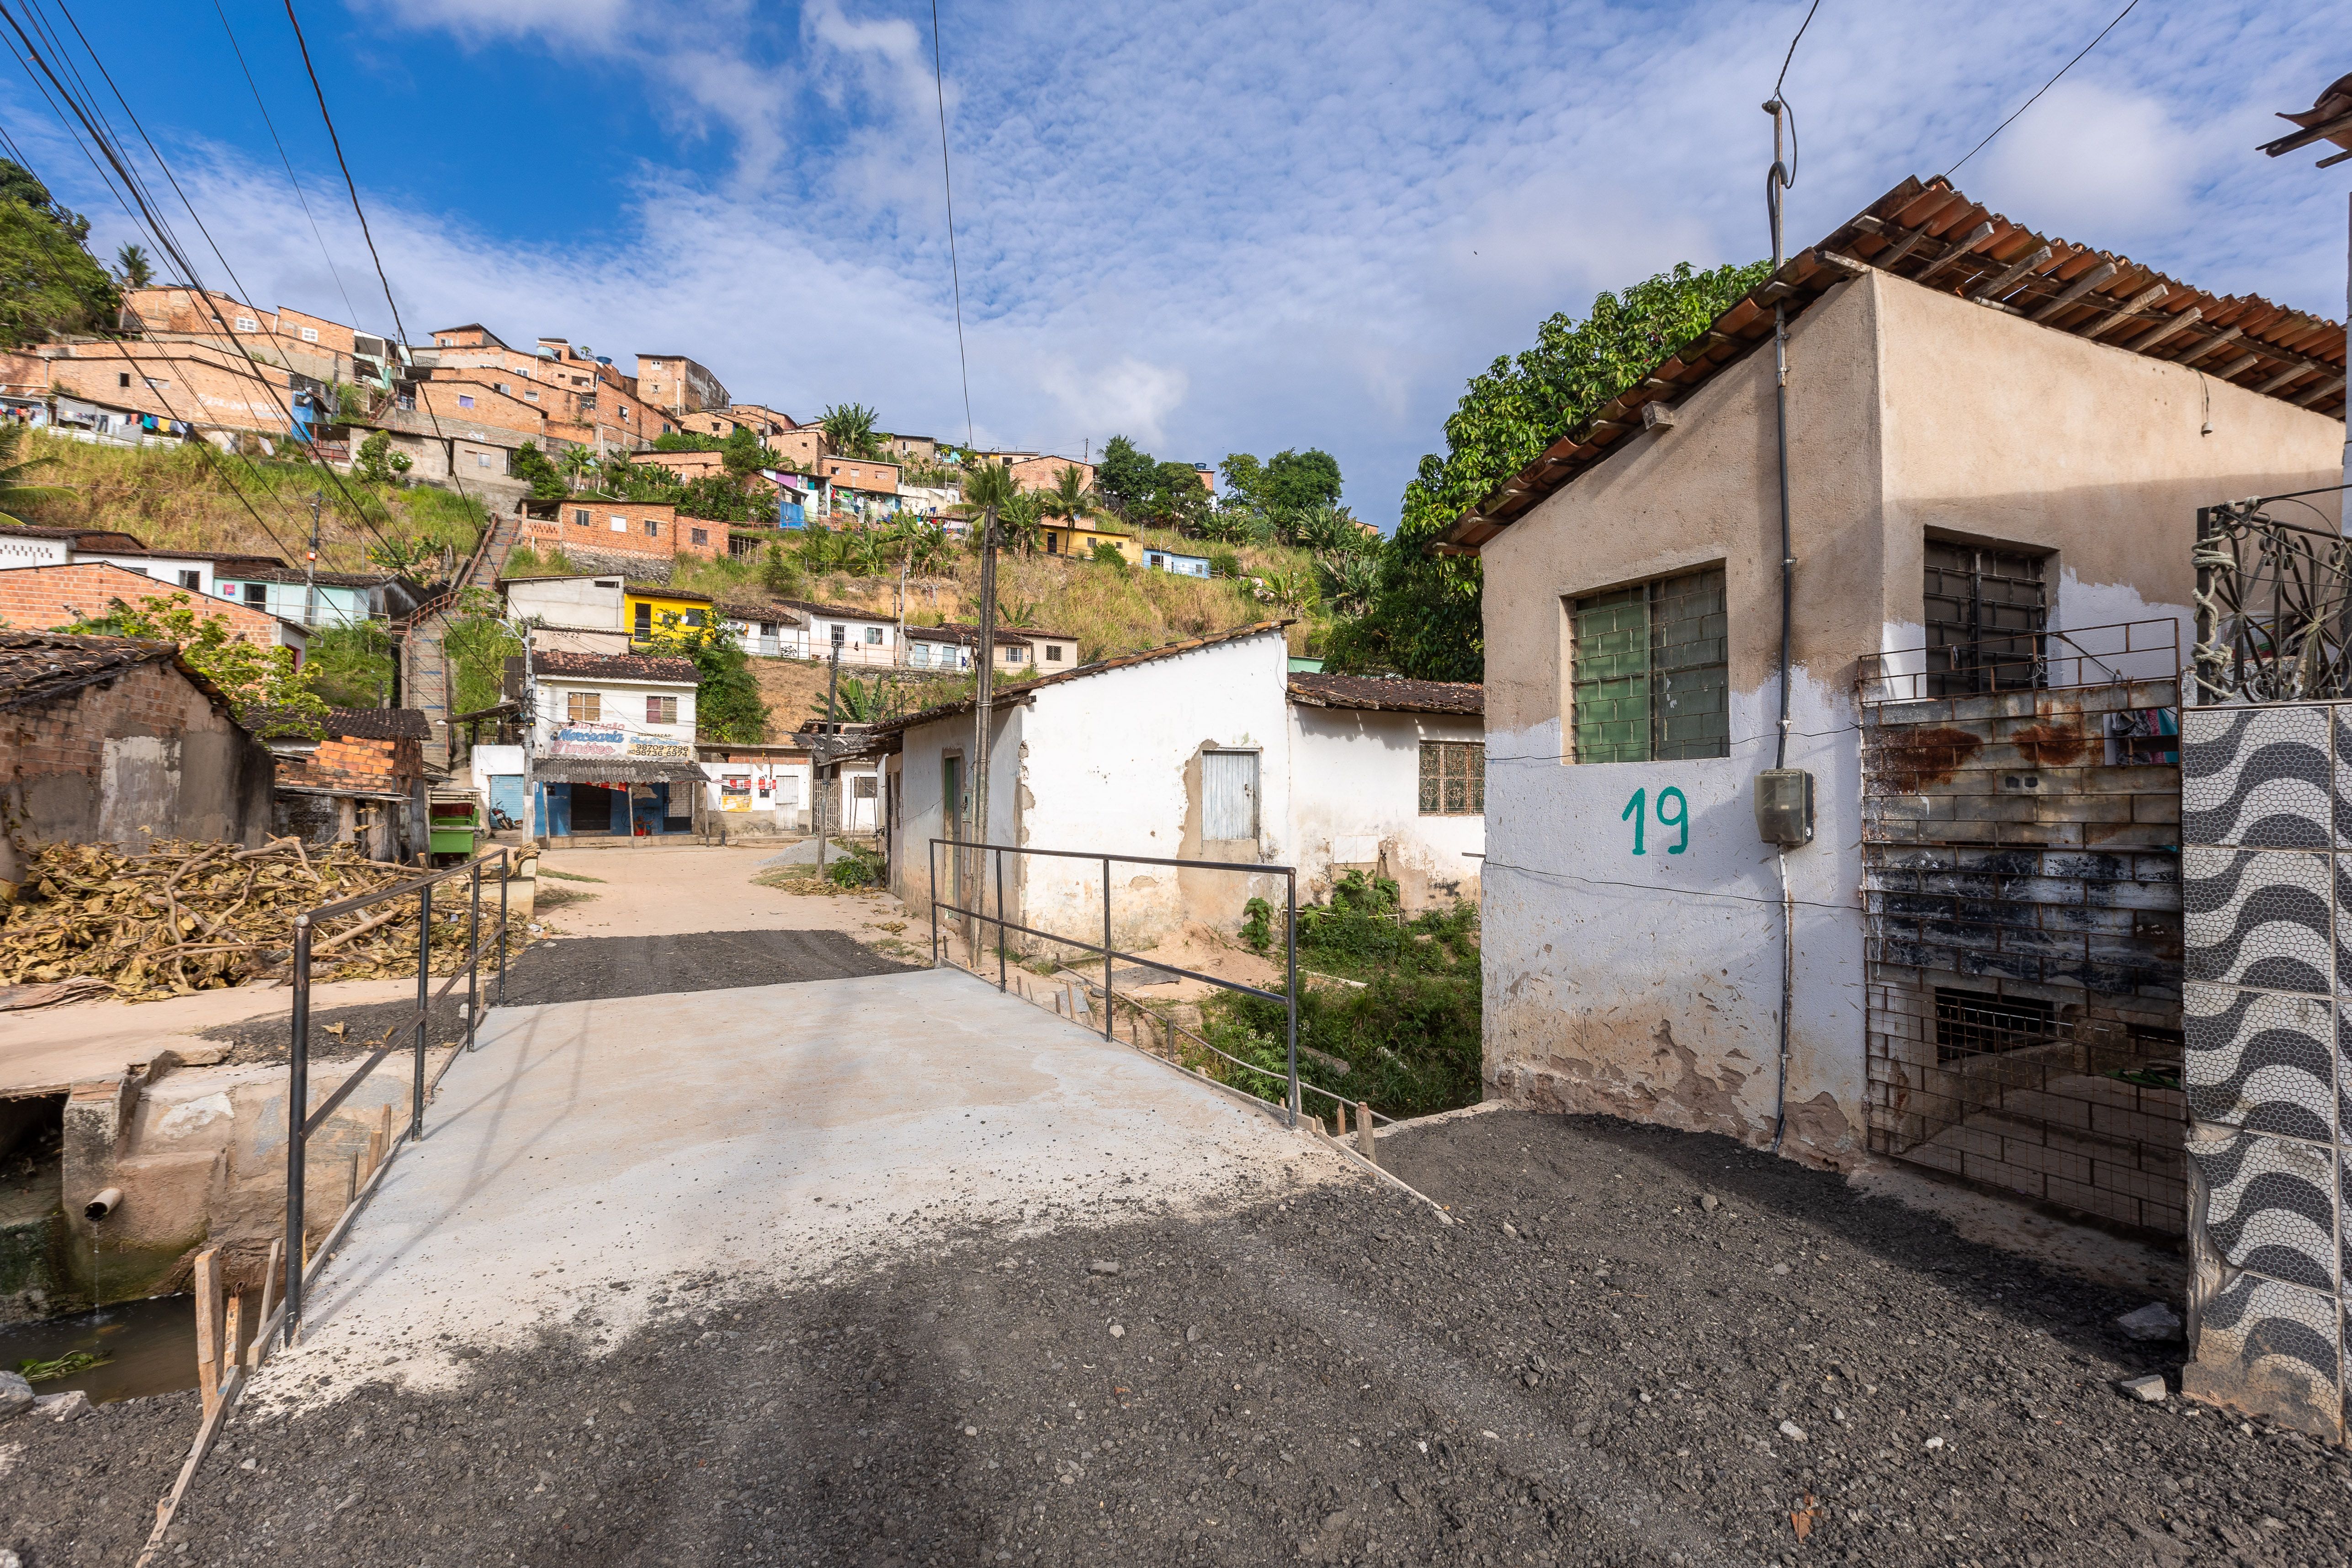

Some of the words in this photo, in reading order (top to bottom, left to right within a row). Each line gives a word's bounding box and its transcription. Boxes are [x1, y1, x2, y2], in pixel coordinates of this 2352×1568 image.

[550, 728, 624, 743] Mercearia
[551, 740, 616, 755] Timóteo
[1621, 786, 1689, 855] 19
